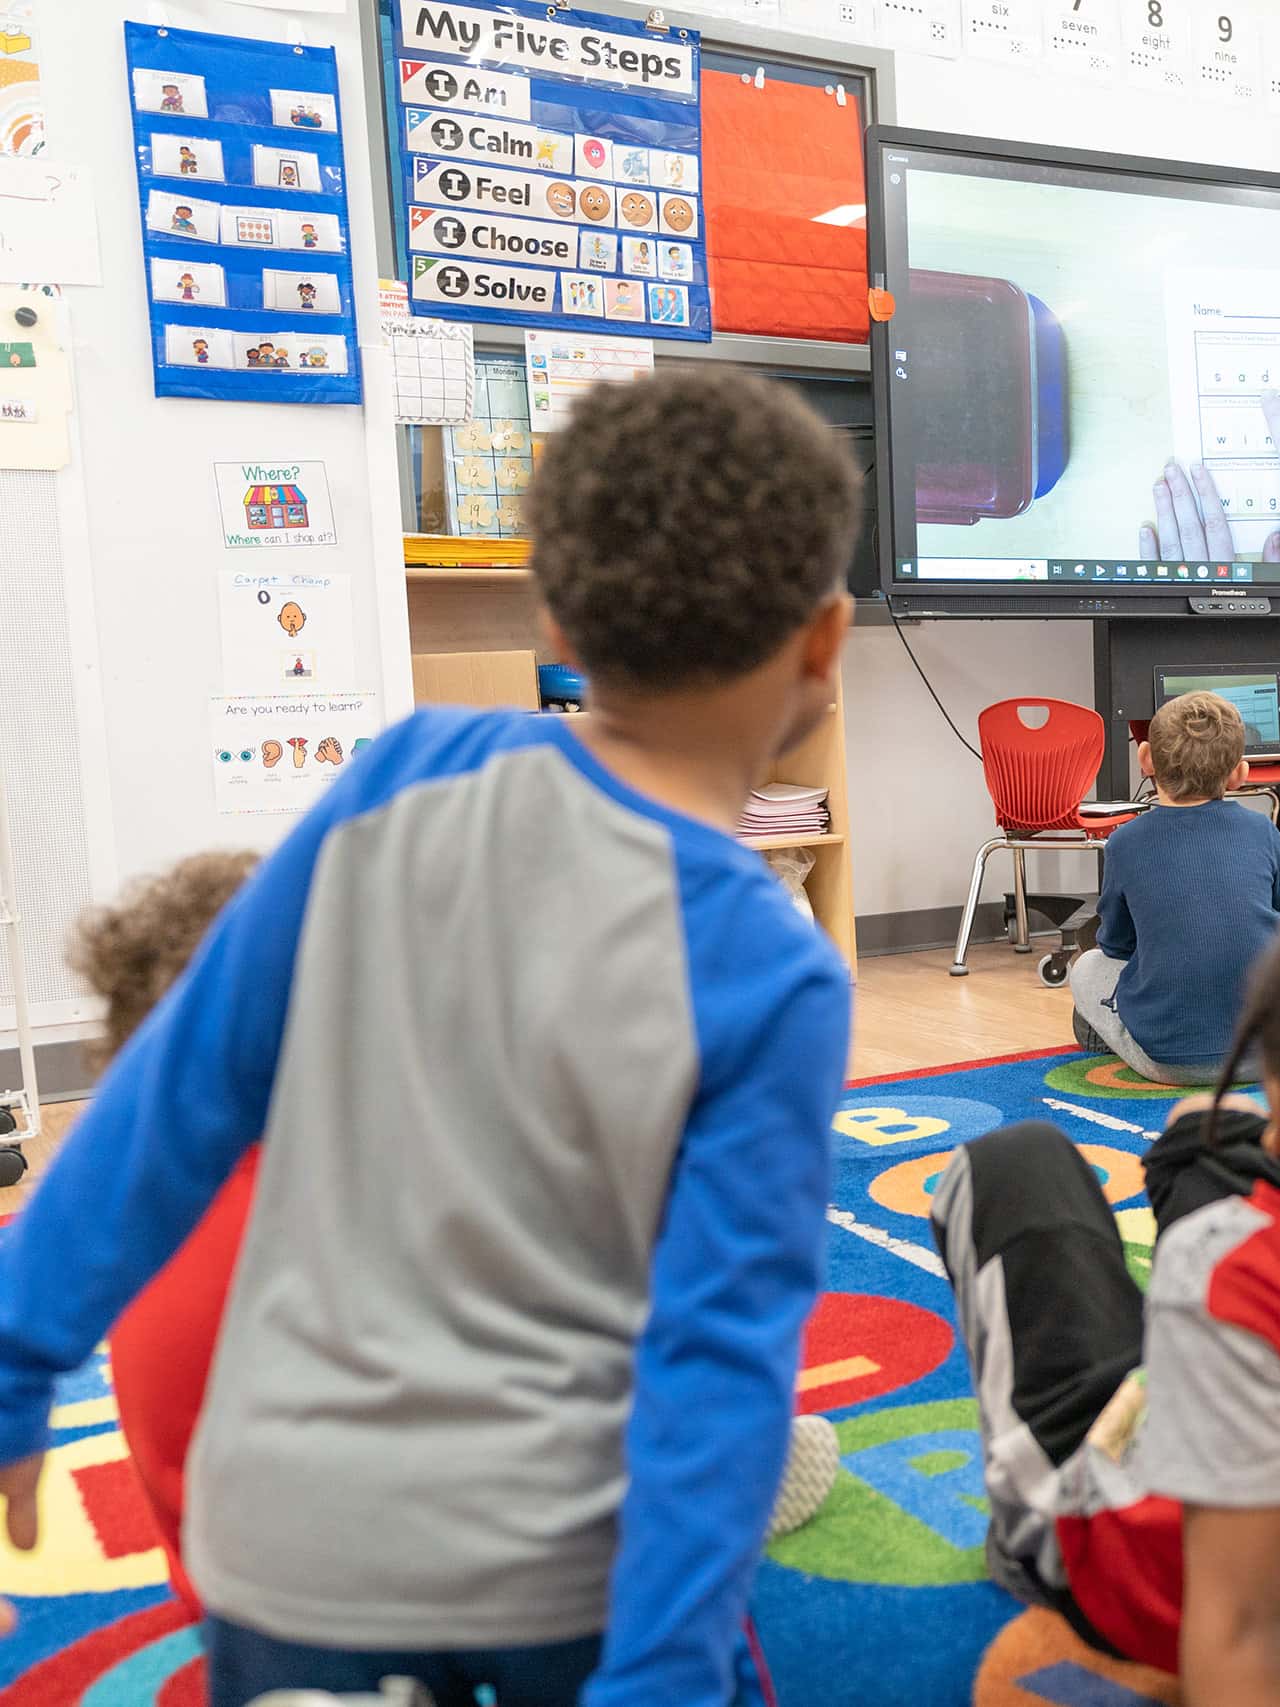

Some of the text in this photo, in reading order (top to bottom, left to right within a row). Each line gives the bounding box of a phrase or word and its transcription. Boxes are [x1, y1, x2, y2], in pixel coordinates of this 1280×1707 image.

[992, 3, 1009, 17] six
[1148, 0, 1164, 28] 8
[1061, 18, 1098, 36] seven
[1217, 15, 1233, 43] 9
[415, 7, 681, 82] My Five Steps
[1141, 32, 1171, 51] eight
[1214, 50, 1237, 64] nine
[404, 64, 413, 76] 1
[463, 79, 507, 107] Am
[410, 112, 419, 124] 2
[469, 127, 533, 158] Calm
[418, 162, 428, 174] 3
[476, 177, 531, 206] Feel
[413, 211, 424, 223] 4
[471, 225, 569, 258] Choose
[416, 260, 427, 272] 5
[473, 274, 548, 303] Solve
[1193, 303, 1222, 317] Name
[492, 367, 519, 377] Monday
[242, 465, 300, 481] Where?
[226, 533, 261, 545] Where
[264, 535, 281, 544] can
[293, 532, 314, 545] shop
[234, 574, 331, 588] Carpet Champ
[225, 700, 363, 717] Are you ready to learn?
[831, 1106, 951, 1147] B
